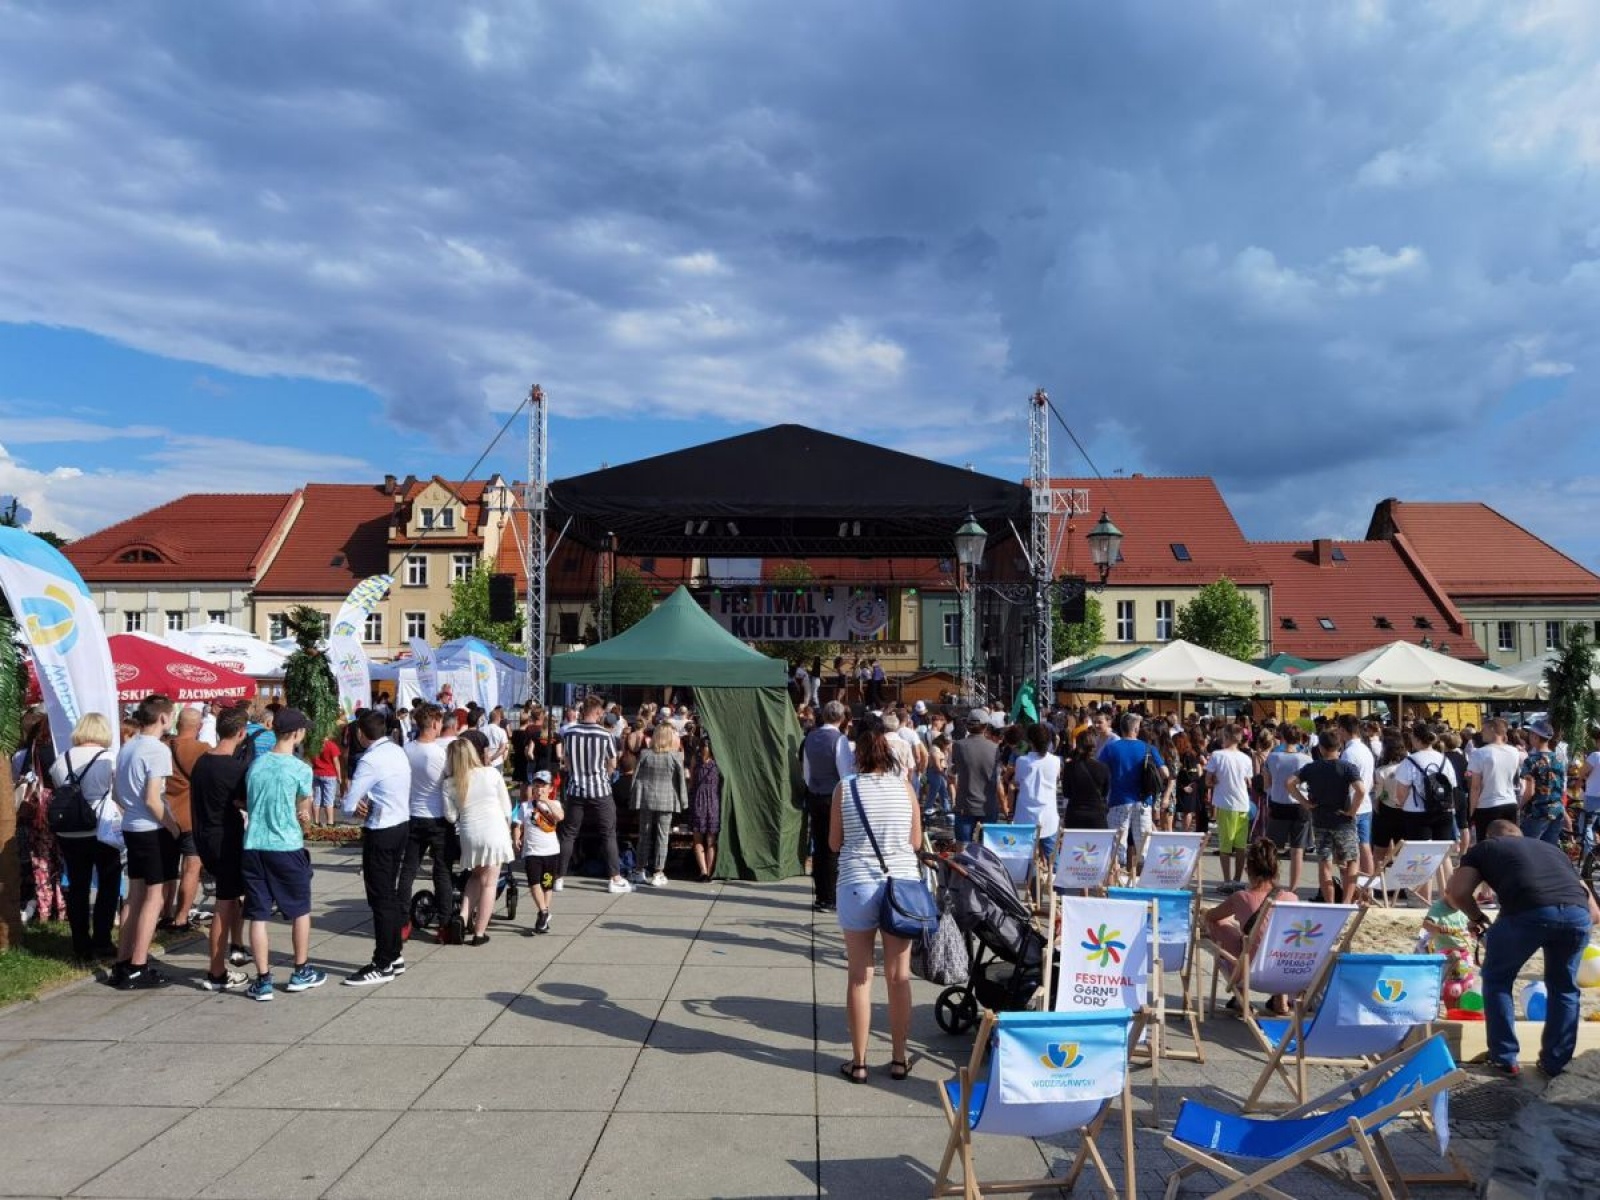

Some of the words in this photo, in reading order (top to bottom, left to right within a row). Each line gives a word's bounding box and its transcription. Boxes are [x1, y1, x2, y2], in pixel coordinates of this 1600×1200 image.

[720, 591, 817, 614] FESTIWAL
[731, 615, 835, 639] KULTURY
[1075, 973, 1135, 986] FESTIWAL
[1073, 995, 1108, 1007] ODRY
